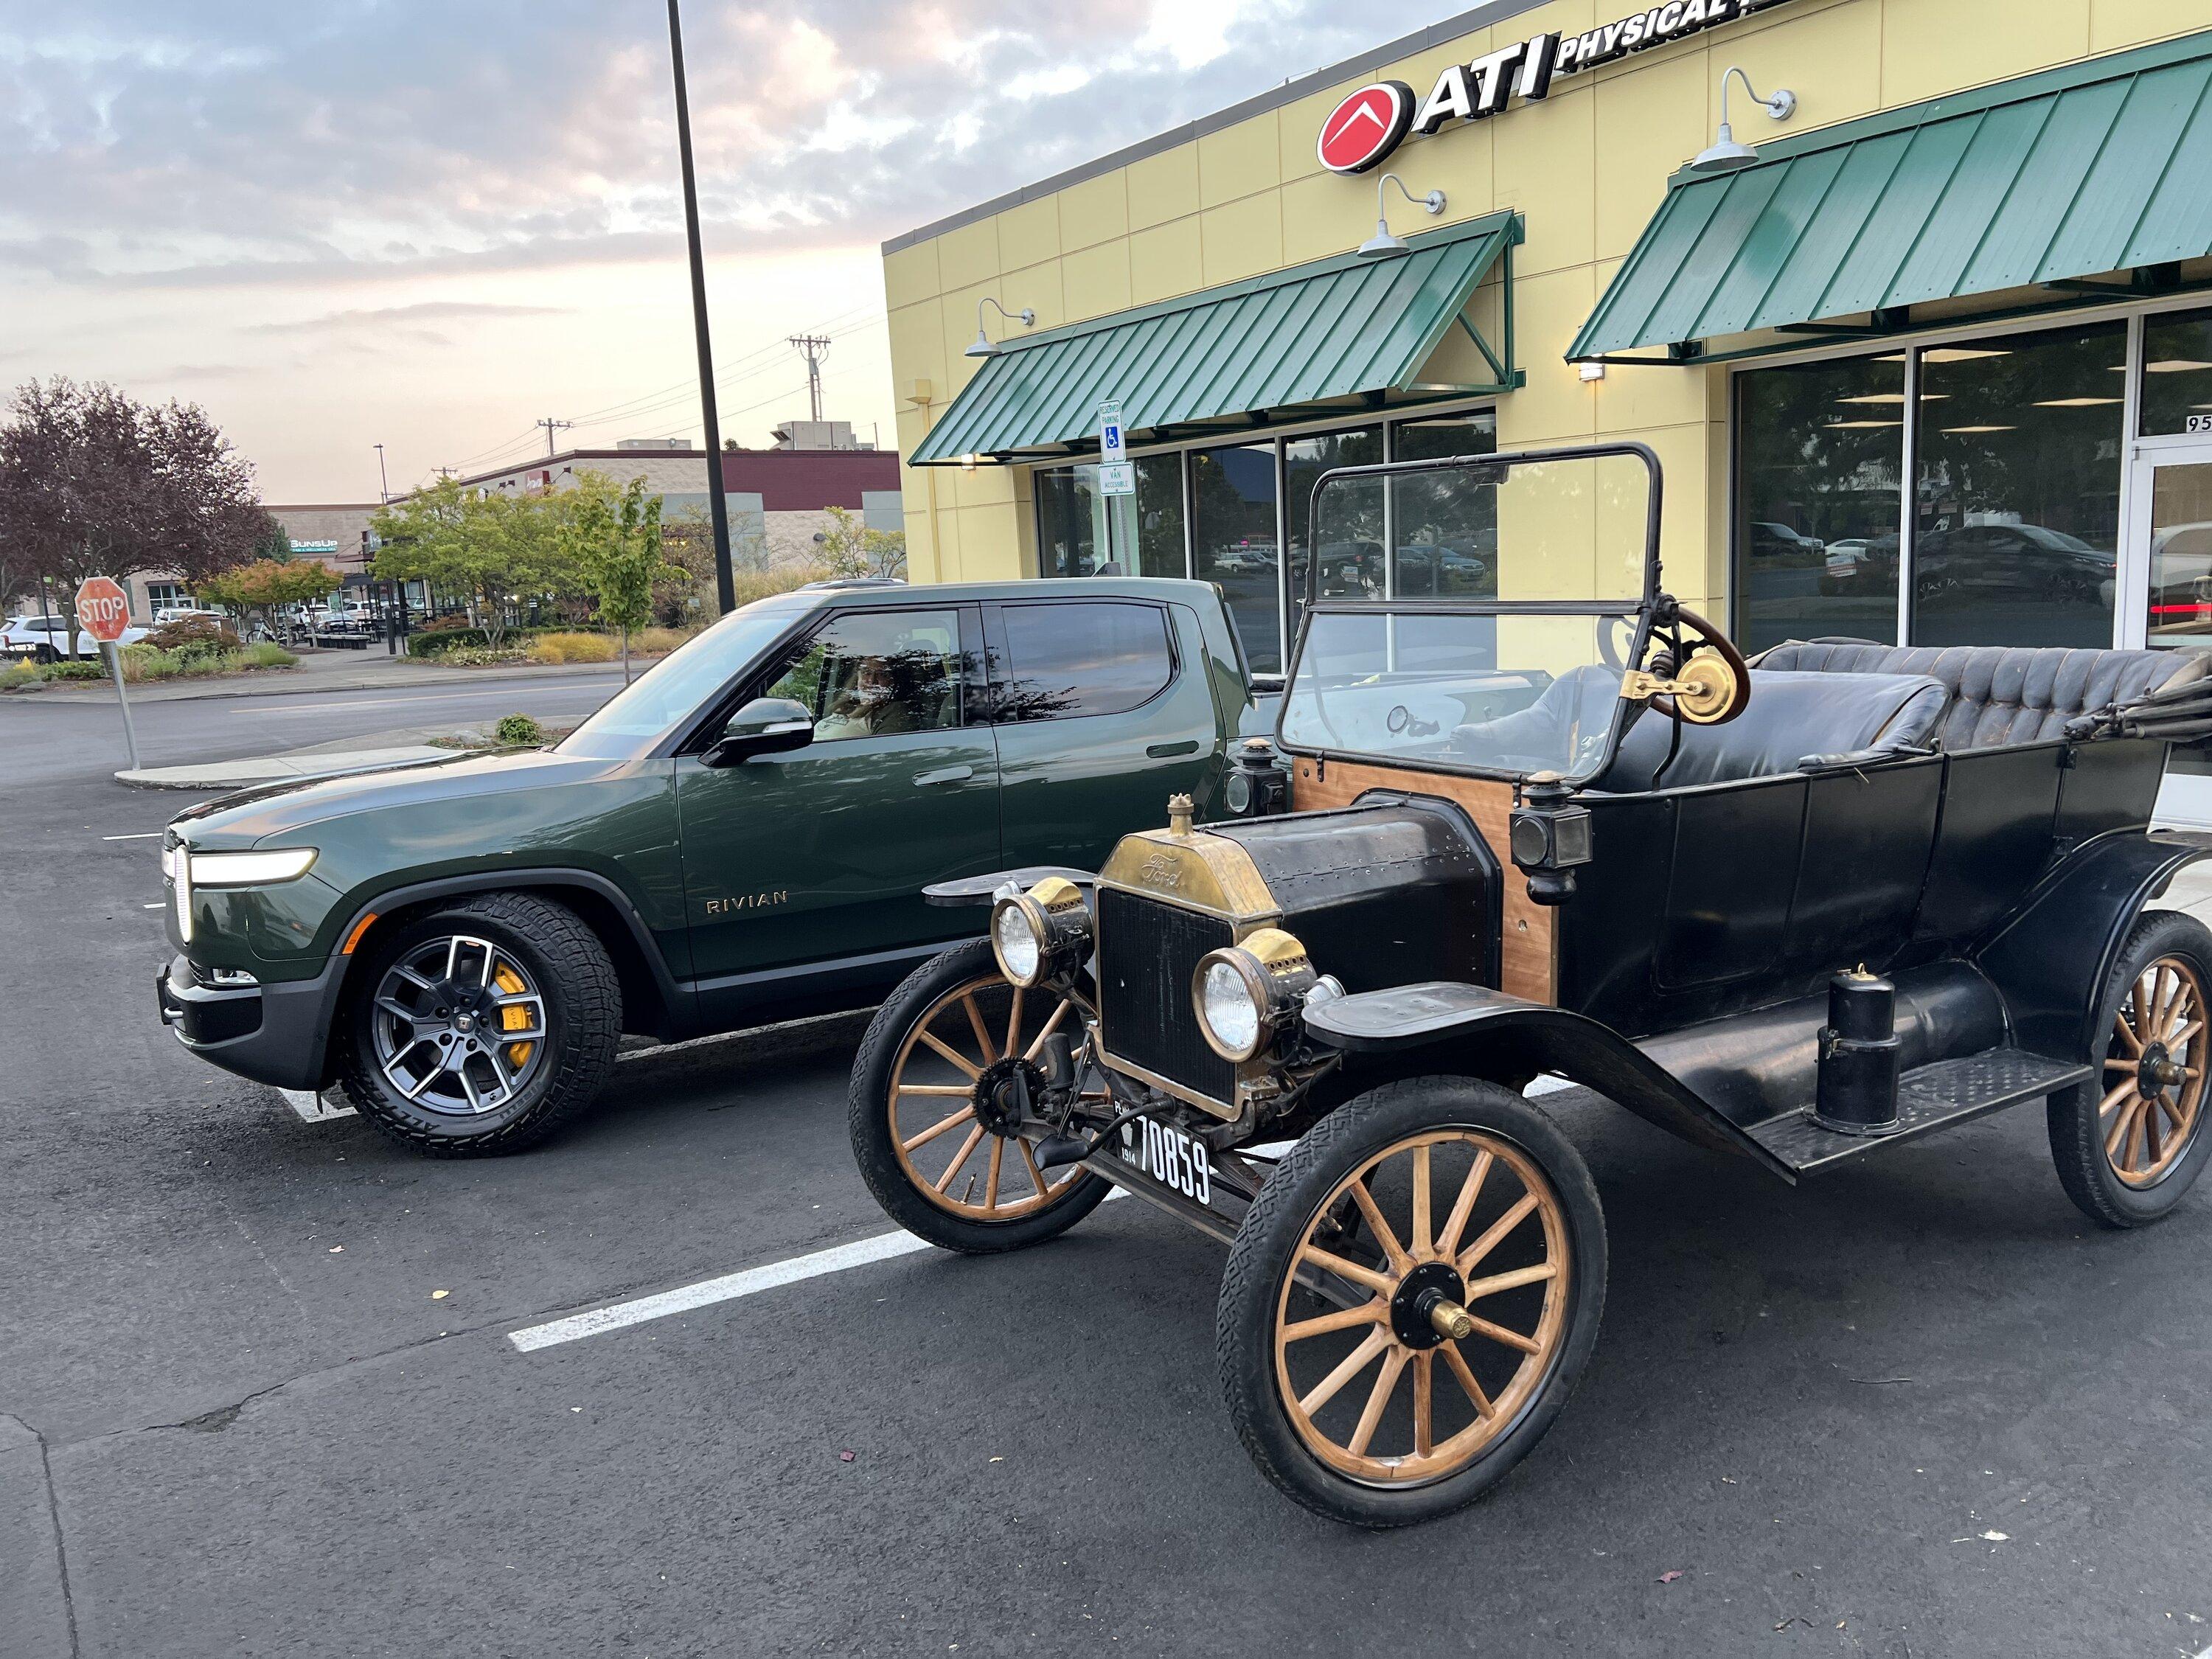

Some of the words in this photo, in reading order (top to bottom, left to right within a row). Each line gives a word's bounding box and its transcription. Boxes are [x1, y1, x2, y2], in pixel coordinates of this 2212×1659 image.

[1411, 33, 1551, 133] ATI
[1555, 0, 1728, 69] PHYSICAL
[1100, 404, 1119, 414] RESERVED
[1102, 415, 1119, 424] PARKING
[2188, 416, 2212, 431] 95
[1110, 471, 1121, 479] VAN
[80, 597, 124, 622] STOP
[1141, 853, 1184, 888] Ford
[706, 891, 787, 914] RIVIAN
[1121, 1147, 1135, 1165] 1914
[1136, 1115, 1210, 1205] 70859
